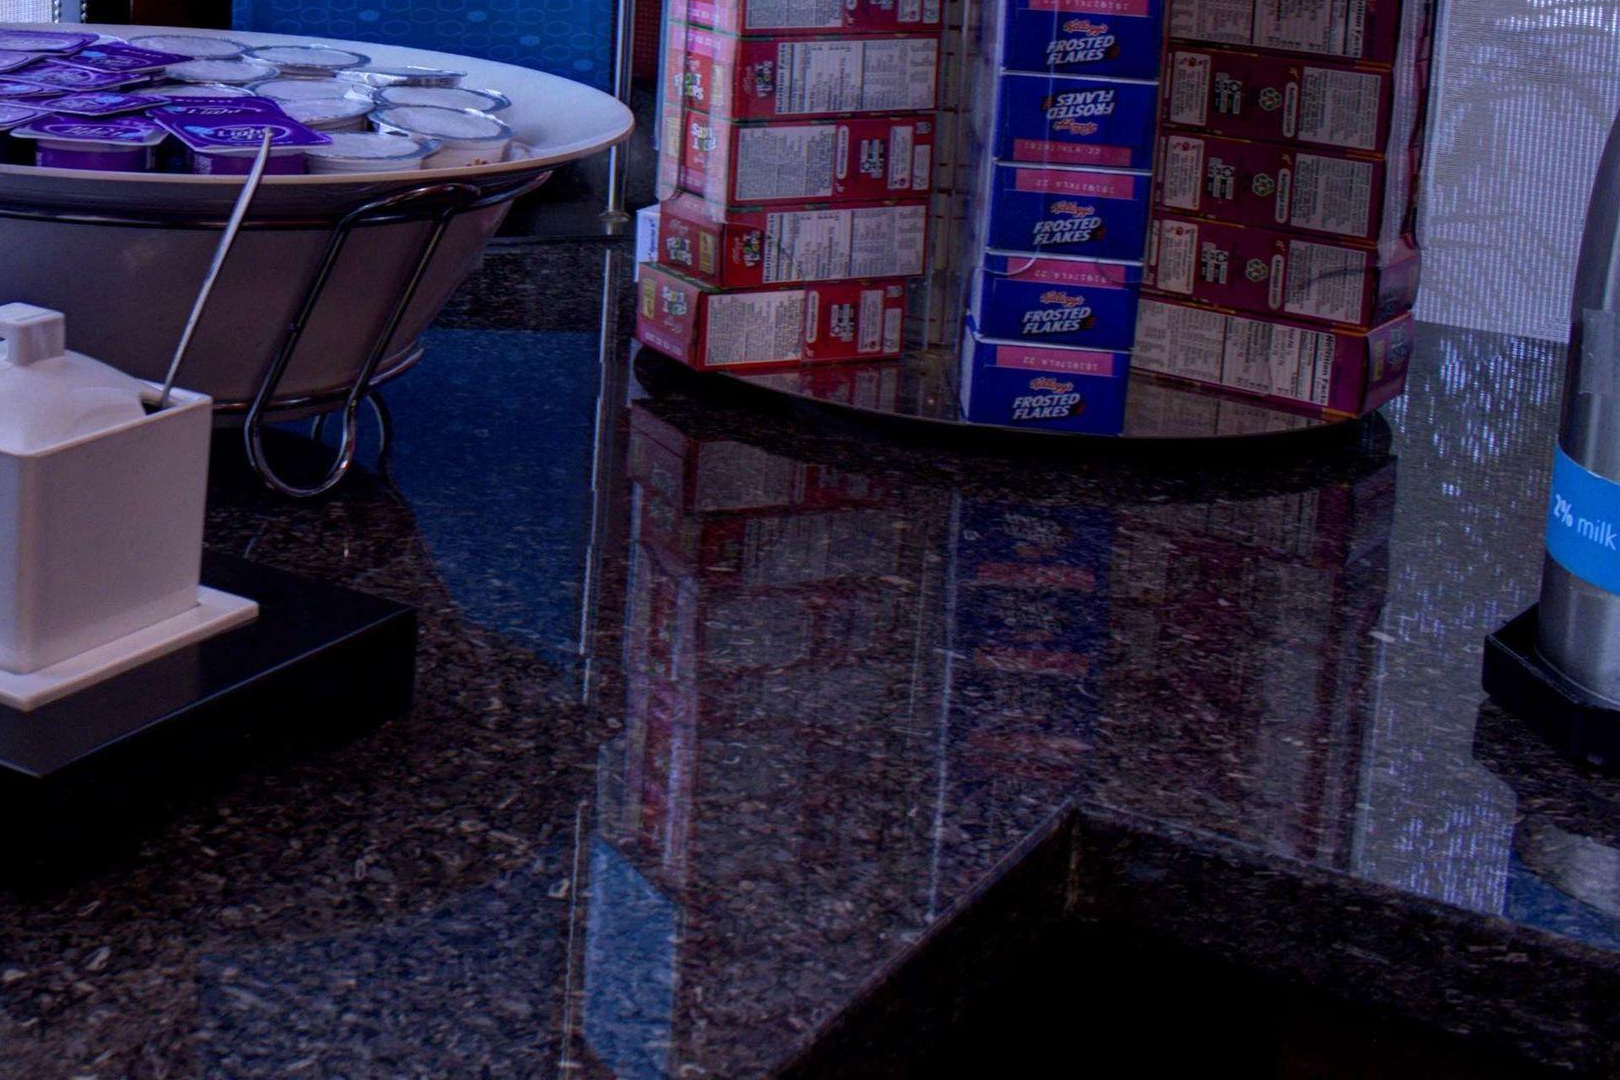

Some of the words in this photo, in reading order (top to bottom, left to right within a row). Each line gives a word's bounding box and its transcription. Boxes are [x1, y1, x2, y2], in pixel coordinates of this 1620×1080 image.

[1046, 35, 1116, 54] FROSTED
[1046, 48, 1106, 65] FLAKES
[1055, 89, 1115, 106] FLAKES
[1046, 102, 1115, 121] FROSTED
[1032, 217, 1102, 235] FROSTED
[1032, 229, 1093, 246] FLAKES
[1021, 306, 1092, 324] FROSTED
[1021, 318, 1082, 335] FLAKES
[1012, 392, 1081, 410] FROSTED
[1011, 403, 1071, 420] FLAKES
[1577, 516, 1618, 551] milk
